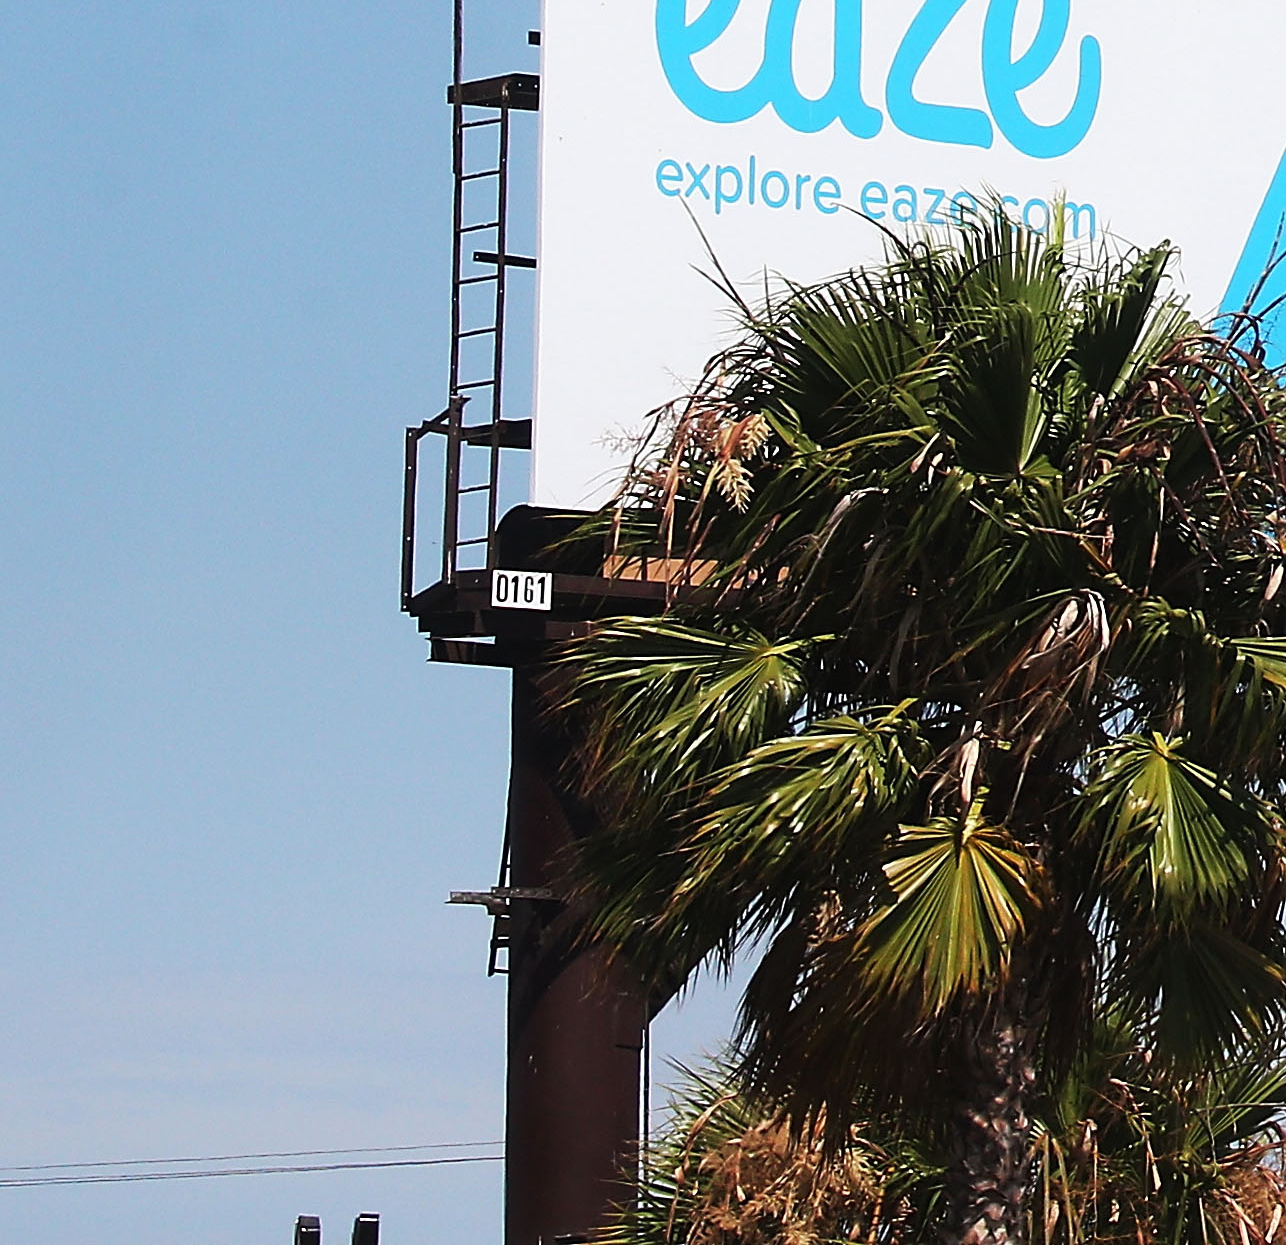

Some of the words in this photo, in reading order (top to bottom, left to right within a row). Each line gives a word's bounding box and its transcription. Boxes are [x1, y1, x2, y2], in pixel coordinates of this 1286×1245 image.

[655, 156, 842, 215] explore
[860, 181, 1097, 241] eazecom
[496, 573, 546, 604] 0161
